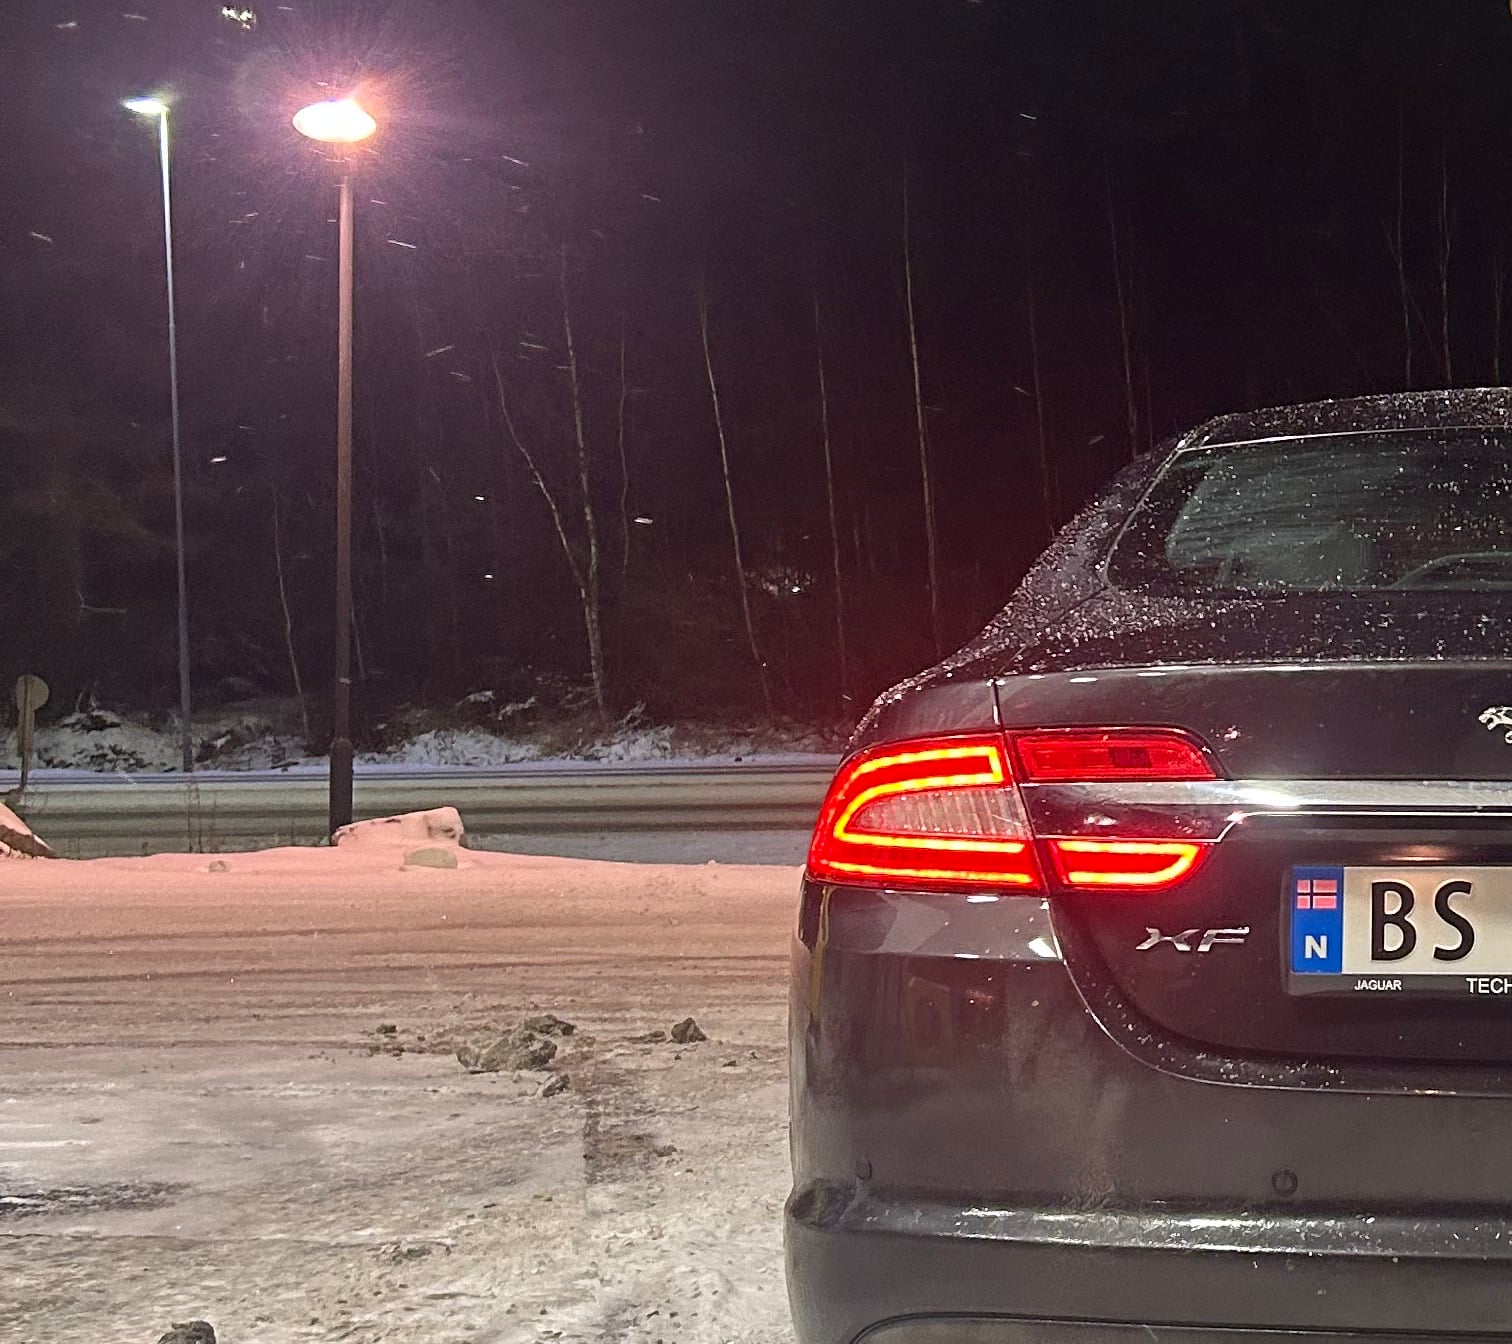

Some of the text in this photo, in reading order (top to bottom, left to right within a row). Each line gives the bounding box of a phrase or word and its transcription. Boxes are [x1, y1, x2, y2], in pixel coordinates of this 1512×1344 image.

[1369, 879, 1476, 962] BS
[1135, 926, 1250, 952] XF
[1304, 935, 1328, 959] N
[1354, 979, 1402, 991] JAGUAR
